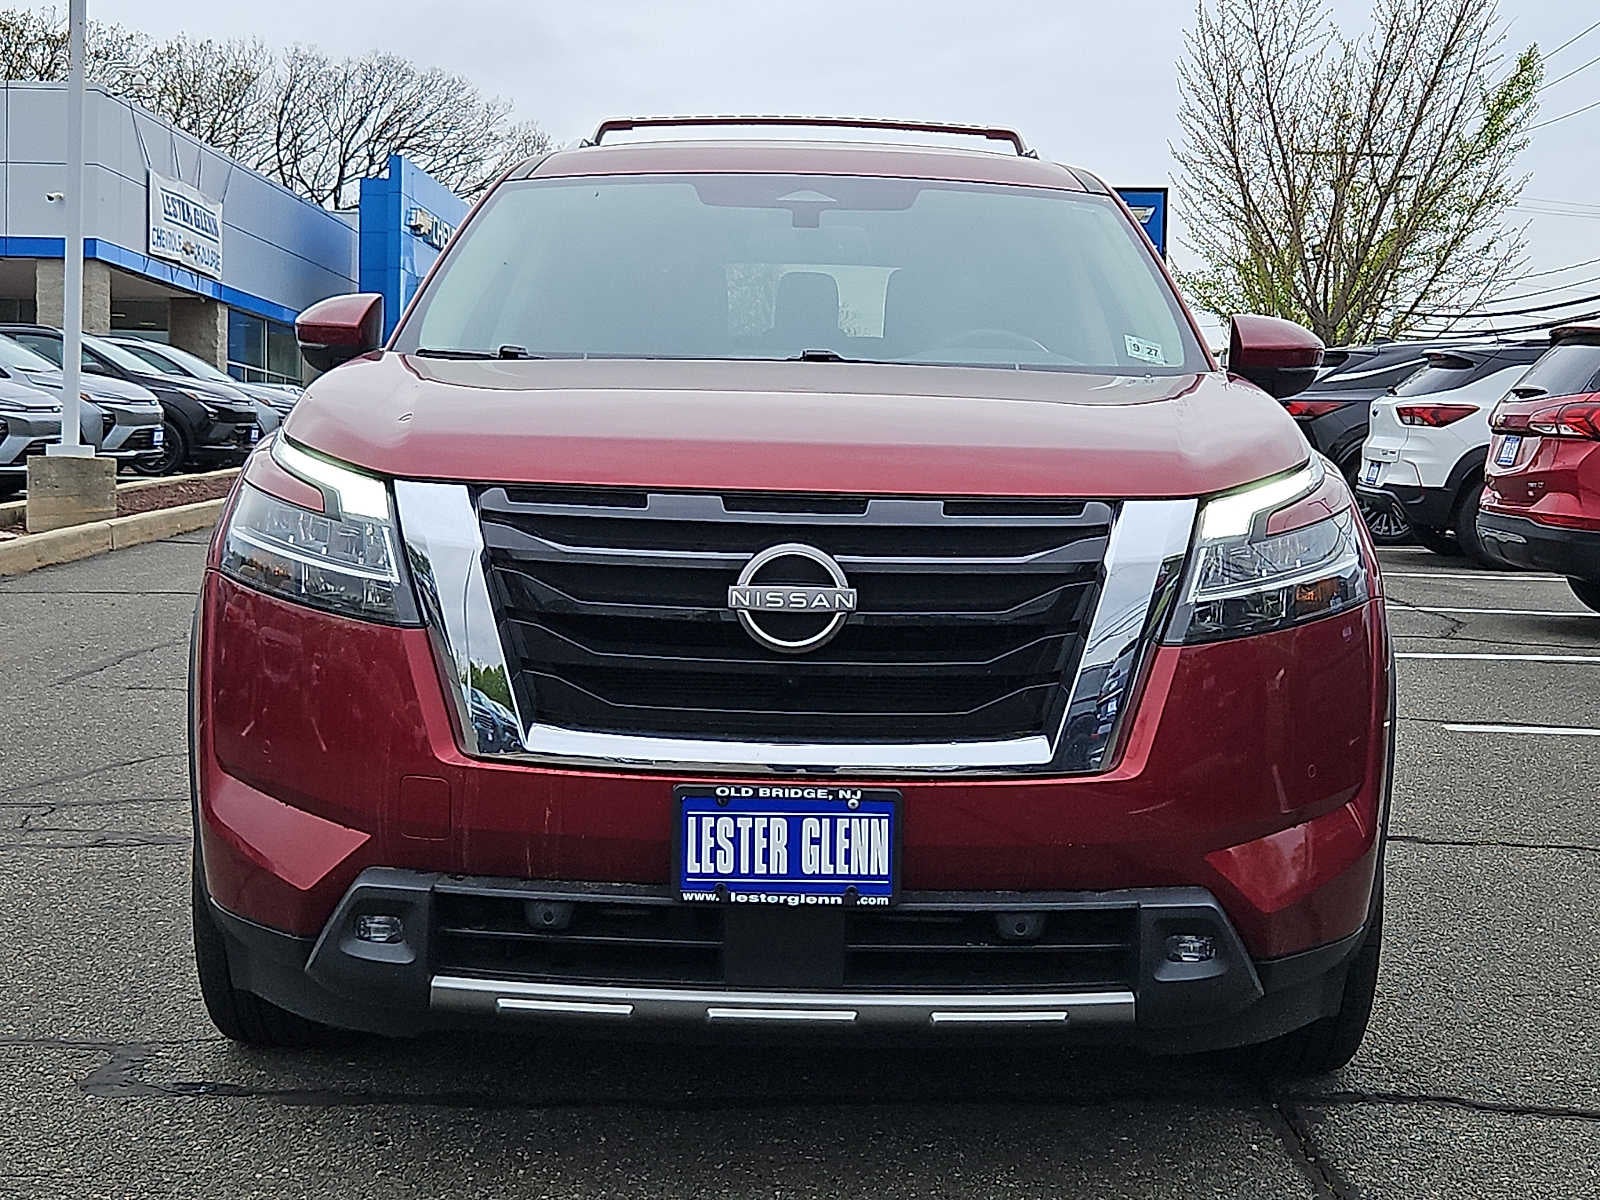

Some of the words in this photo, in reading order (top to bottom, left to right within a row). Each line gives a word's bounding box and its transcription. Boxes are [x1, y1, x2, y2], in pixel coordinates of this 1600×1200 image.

[1146, 346, 1158, 357] 27
[731, 590, 854, 608] NISSAN
[715, 786, 754, 797] OLD
[758, 787, 833, 800] BRIDGE,
[838, 790, 862, 799] NJ
[687, 816, 788, 875] LESTER
[801, 818, 889, 876] GLENN
